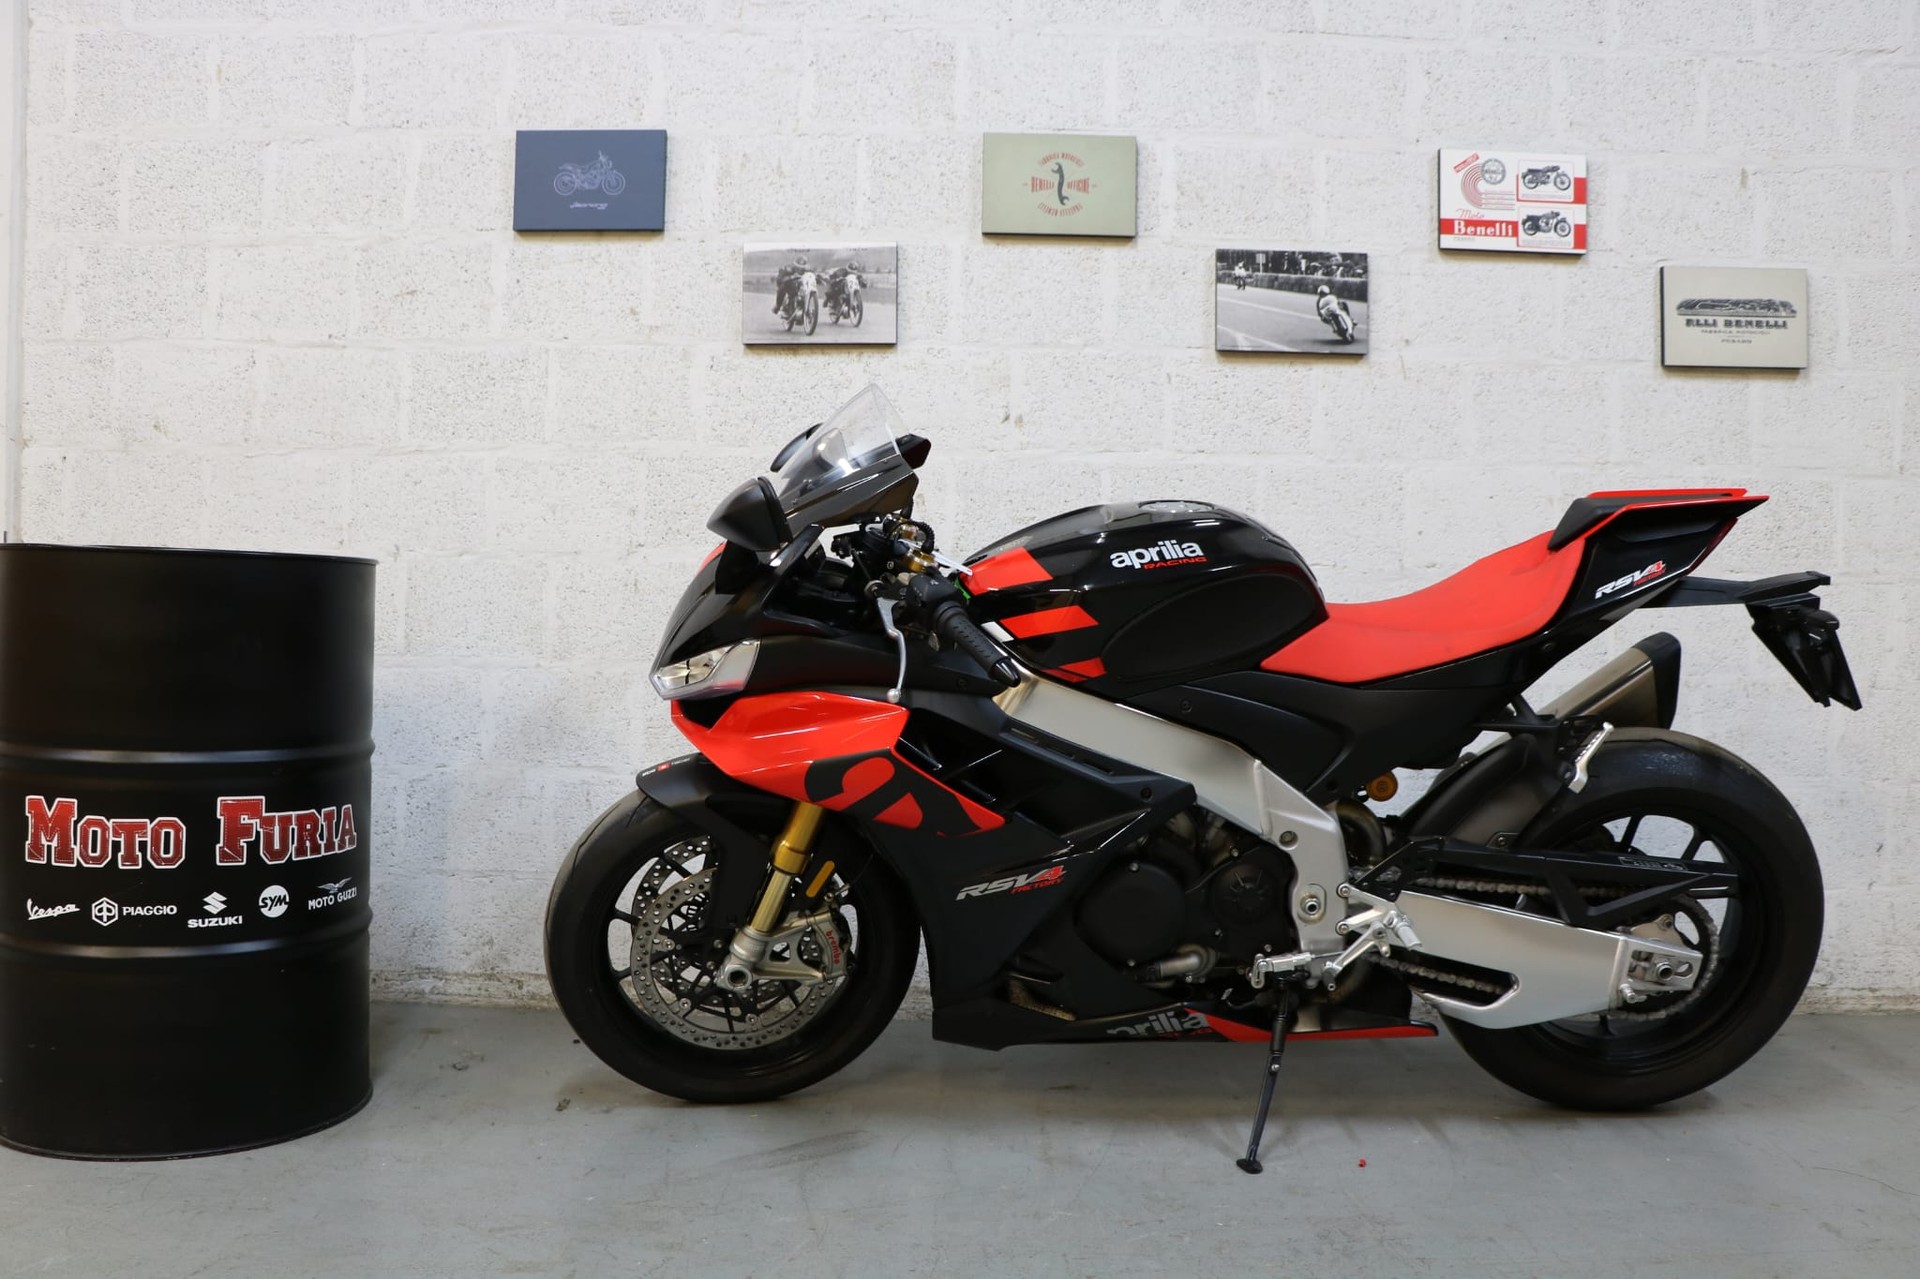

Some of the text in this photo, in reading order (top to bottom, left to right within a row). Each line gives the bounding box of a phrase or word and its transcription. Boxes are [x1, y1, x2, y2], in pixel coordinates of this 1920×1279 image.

[1453, 220, 1513, 236] Benelli
[1724, 318, 1788, 330] BENELLI
[1110, 539, 1204, 569] aprilia
[1143, 556, 1208, 570] RACING
[1594, 560, 1666, 599] RSV4
[26, 795, 357, 869] MOTO FURIA
[956, 865, 1067, 901] RSV4
[26, 898, 80, 920] Vespa
[259, 894, 289, 909] SYM
[307, 886, 358, 911] MOTO GUZZI
[122, 904, 177, 916] PIAGGIO
[187, 915, 243, 929] SUZUKI
[826, 930, 842, 965] brembo
